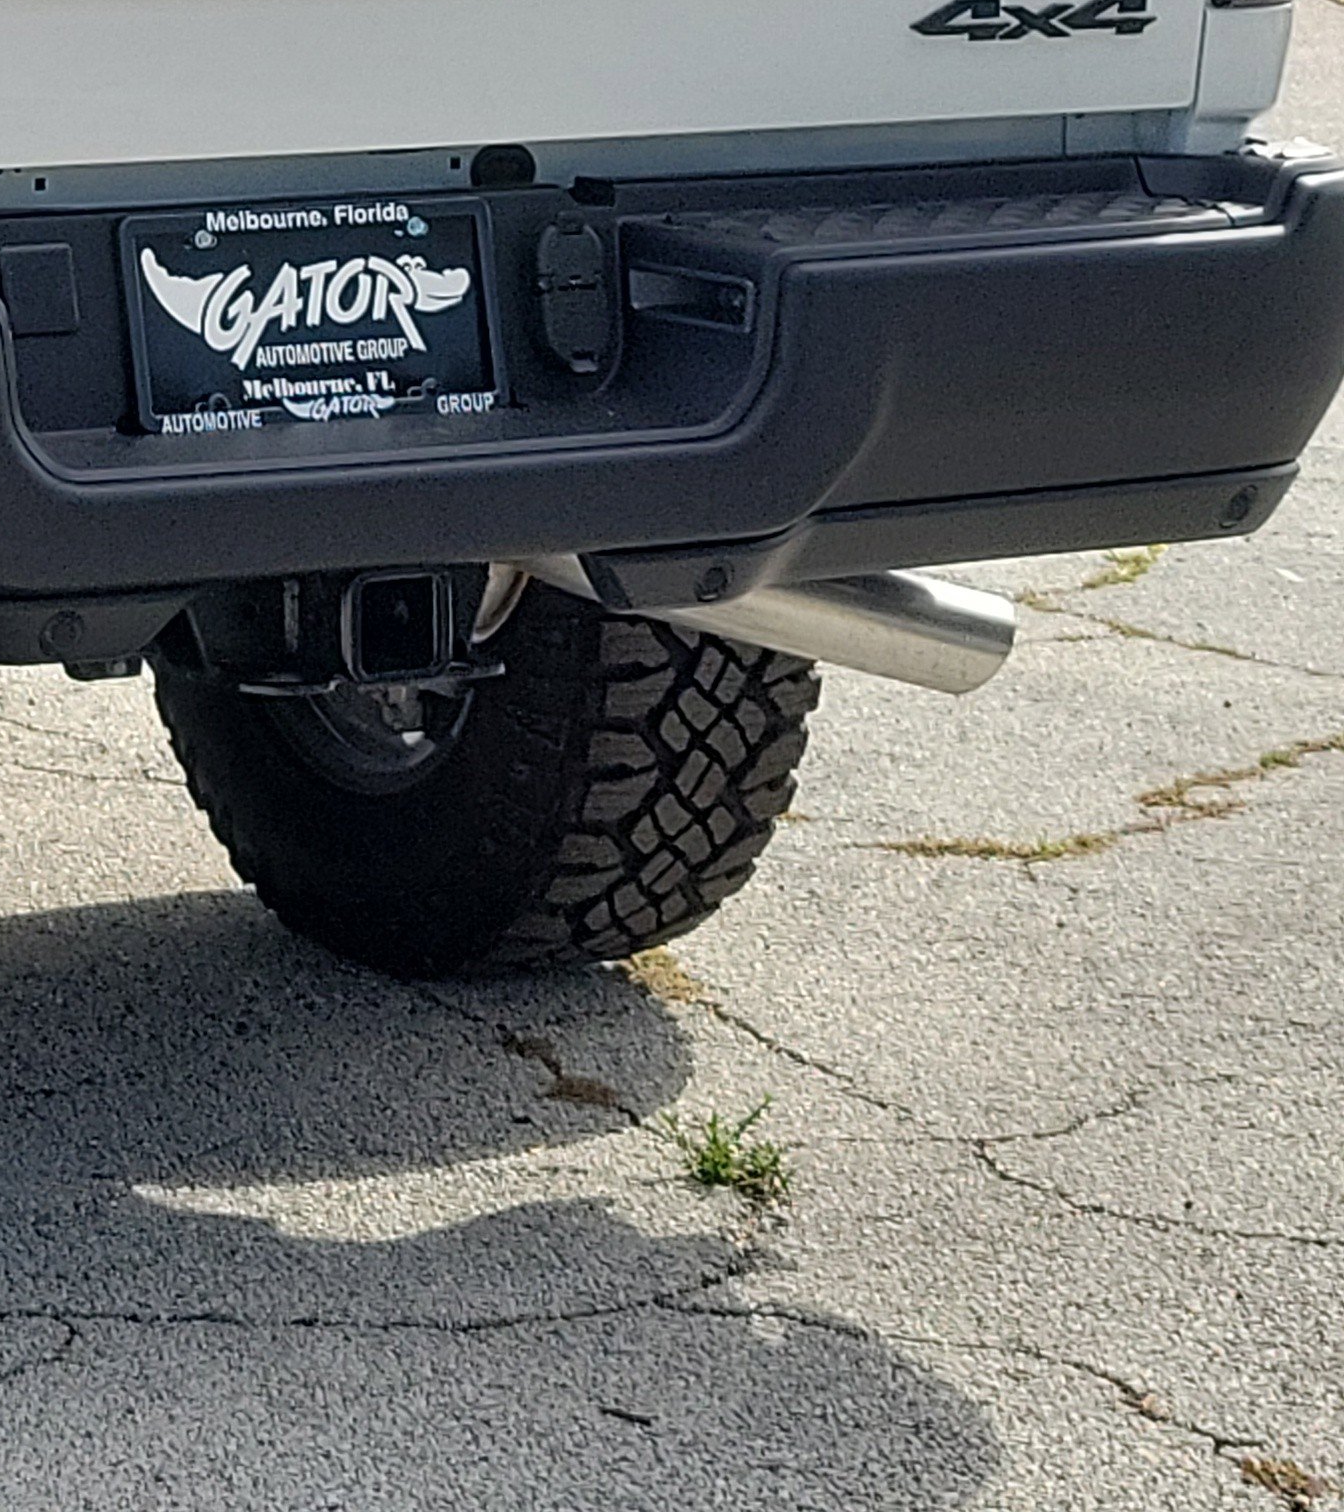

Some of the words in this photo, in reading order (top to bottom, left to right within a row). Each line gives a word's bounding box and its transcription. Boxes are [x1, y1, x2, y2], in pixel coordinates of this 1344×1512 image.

[206, 210, 328, 232] Melbourne,
[334, 202, 409, 226] Florida
[204, 255, 427, 371] GATOR
[255, 344, 354, 369] AUTOMOTIVE
[356, 338, 408, 362] GROUP
[367, 370, 396, 391] FL
[161, 411, 262, 435] AUTOMOTIVE
[311, 394, 380, 422] GATOR
[437, 393, 494, 415] GROUP
